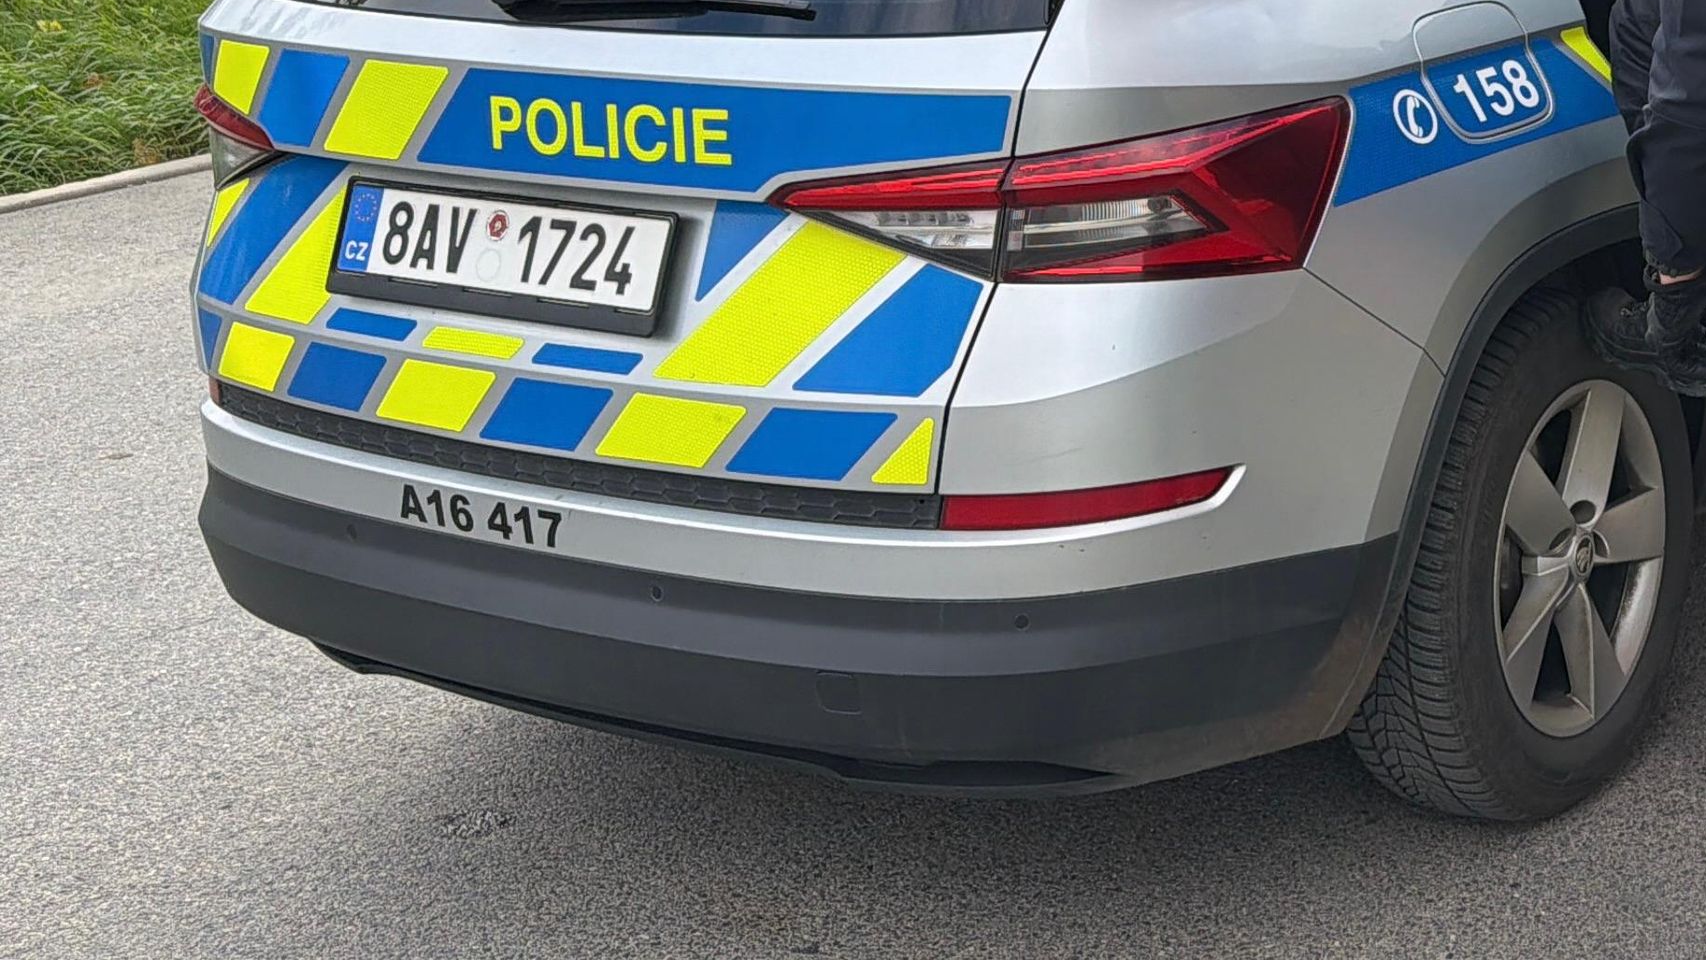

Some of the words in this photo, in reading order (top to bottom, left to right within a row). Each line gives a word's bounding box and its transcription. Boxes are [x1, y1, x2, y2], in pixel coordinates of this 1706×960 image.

[1453, 59, 1540, 123] 158
[489, 95, 733, 166] POLICIE
[344, 240, 369, 262] CZ
[381, 200, 478, 274] 8AV
[516, 215, 636, 296] 1724
[400, 483, 475, 533] A16
[487, 501, 562, 549] 417
